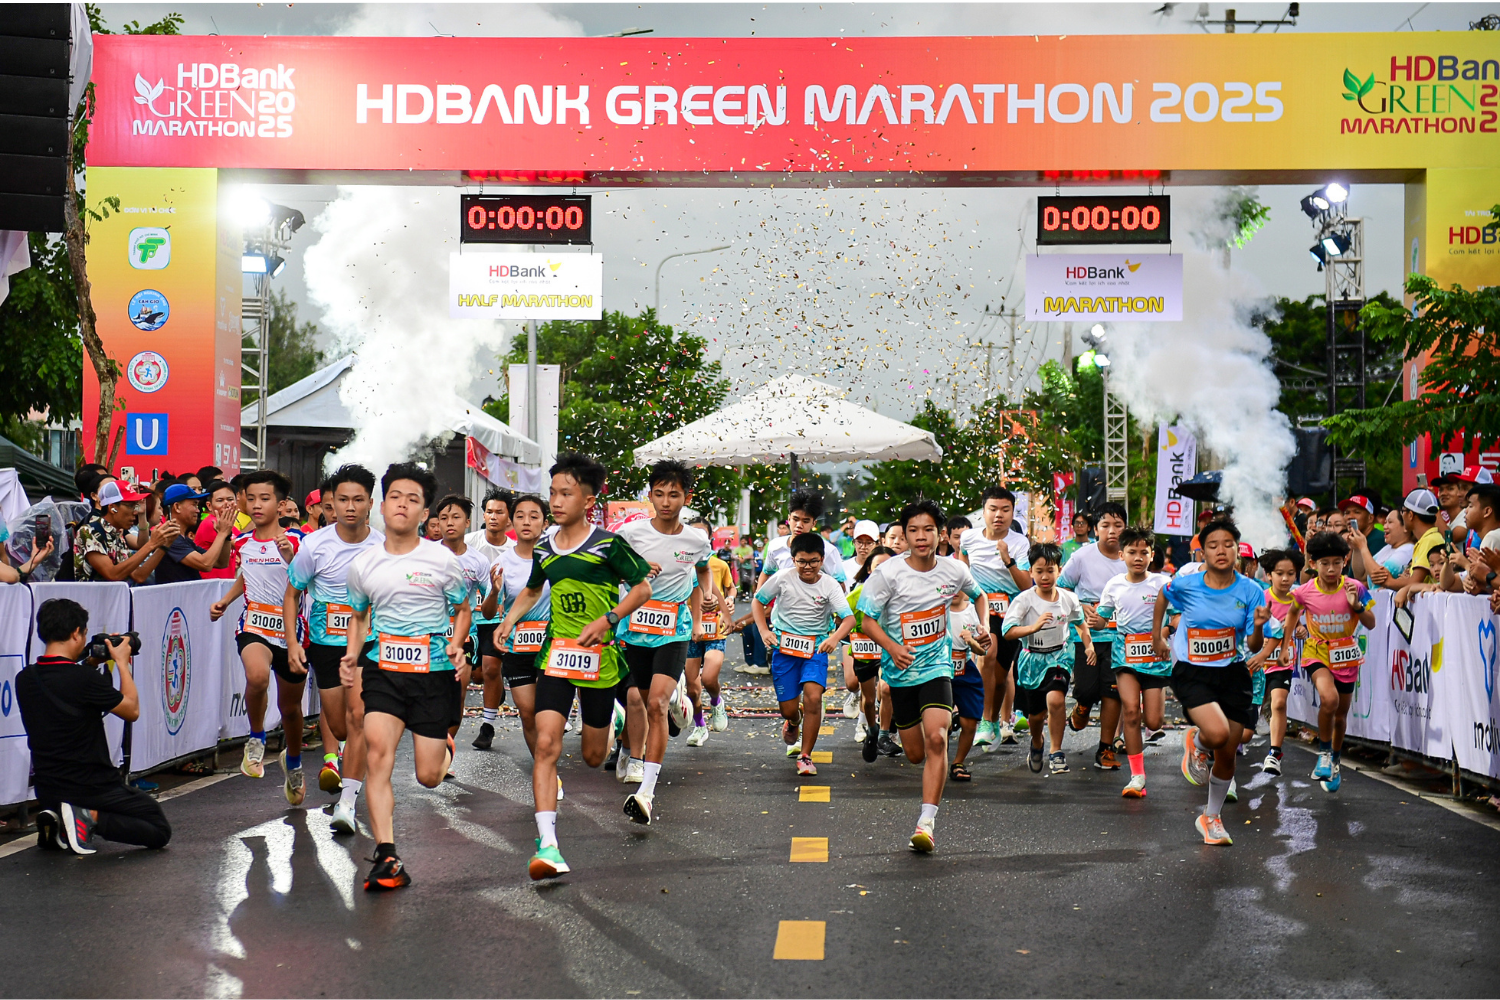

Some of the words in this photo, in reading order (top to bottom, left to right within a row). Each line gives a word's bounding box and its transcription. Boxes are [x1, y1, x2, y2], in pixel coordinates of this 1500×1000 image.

[177, 62, 296, 90] HDBank
[1390, 55, 1499, 82] HDBan
[148, 85, 256, 118] GREEN
[257, 91, 296, 114] 20
[355, 83, 590, 126] HDBANK
[605, 83, 787, 127] GREEN
[803, 81, 1131, 126] MARATHON
[1150, 80, 1284, 124] 2025
[1357, 80, 1476, 115] GREEN
[1479, 84, 1499, 107] 2
[132, 119, 256, 137] MARATHON
[257, 115, 294, 138] 25
[1340, 116, 1476, 135] MARATHON
[1479, 110, 1499, 133] 2
[468, 206, 584, 231] 0:00:00
[1043, 205, 1161, 231] 0:00:00
[1449, 226, 1499, 245] HDB
[488, 264, 546, 278] HDBank
[1066, 266, 1126, 279] HDBank
[457, 293, 498, 308] HALF
[501, 293, 593, 308] MARATHON
[1043, 296, 1165, 313] MARATHON
[1167, 451, 1185, 528] HDBank
[988, 602, 1004, 612] 031
[251, 613, 283, 630] 31008
[334, 616, 351, 628] 310
[636, 610, 670, 627] 31020
[910, 619, 940, 638] 31017
[1319, 623, 1345, 634] RUN
[785, 637, 809, 650] 31014
[854, 641, 879, 652] 30001
[1130, 644, 1153, 656] 3103
[1193, 638, 1231, 654] 30004
[385, 645, 422, 661] 31002
[556, 653, 591, 669] 31019
